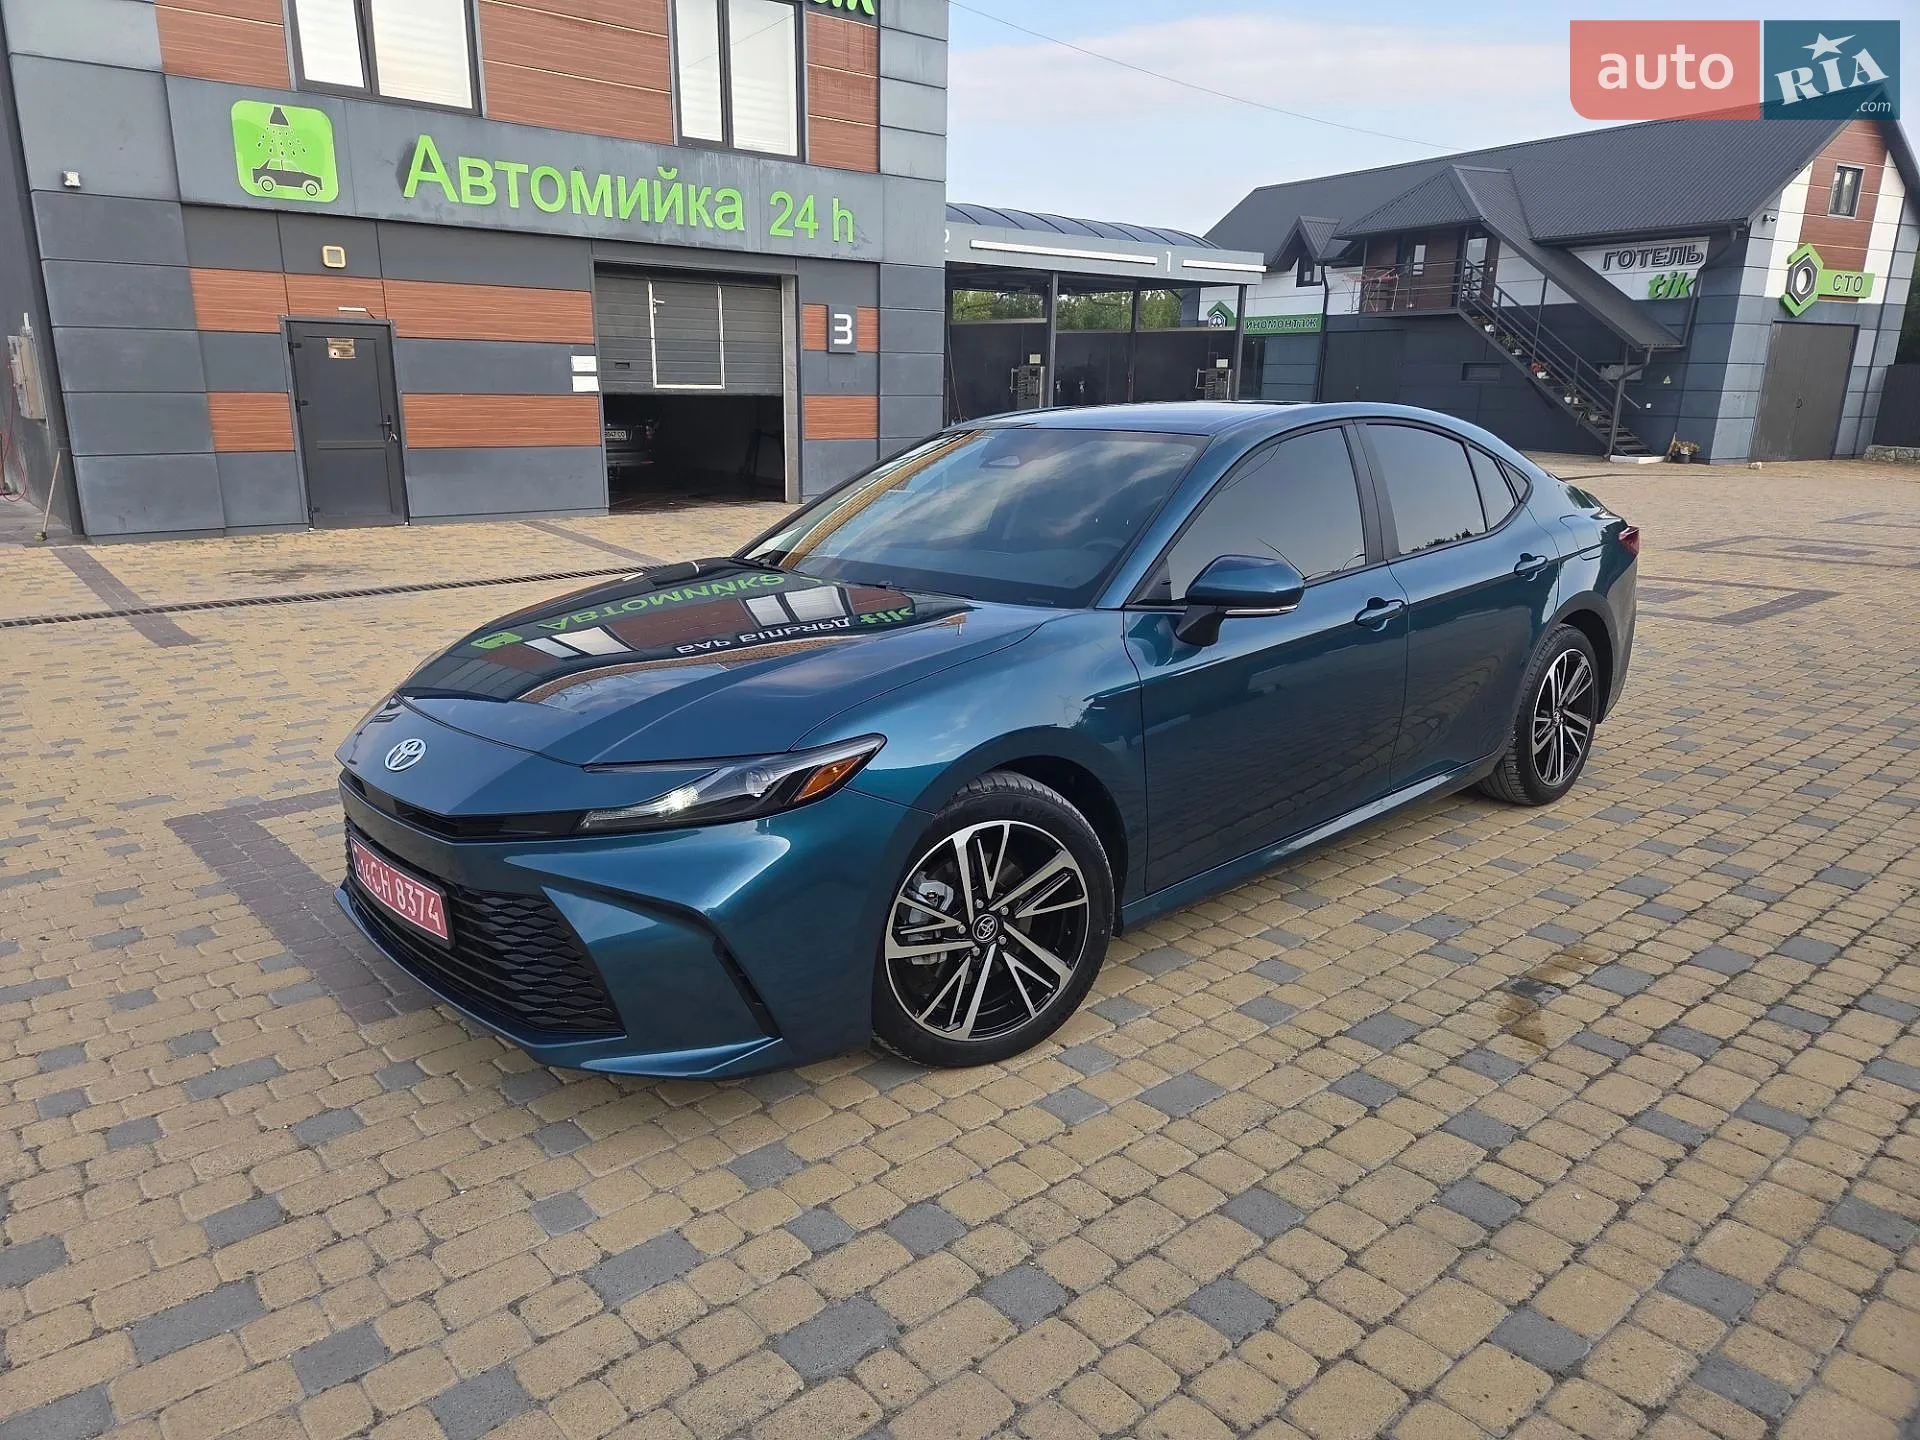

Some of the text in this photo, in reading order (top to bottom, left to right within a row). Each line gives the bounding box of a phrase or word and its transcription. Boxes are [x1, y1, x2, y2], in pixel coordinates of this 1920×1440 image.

[403, 133, 856, 244] Автомийка 24 h
[1602, 244, 1704, 271] ГОТЕЛЬ
[1647, 271, 1696, 298] tik
[1832, 274, 1864, 293] СТО
[833, 313, 853, 346] 3
[1244, 317, 1319, 330] ИНОМОНТАЖ
[395, 877, 442, 931] 8374
